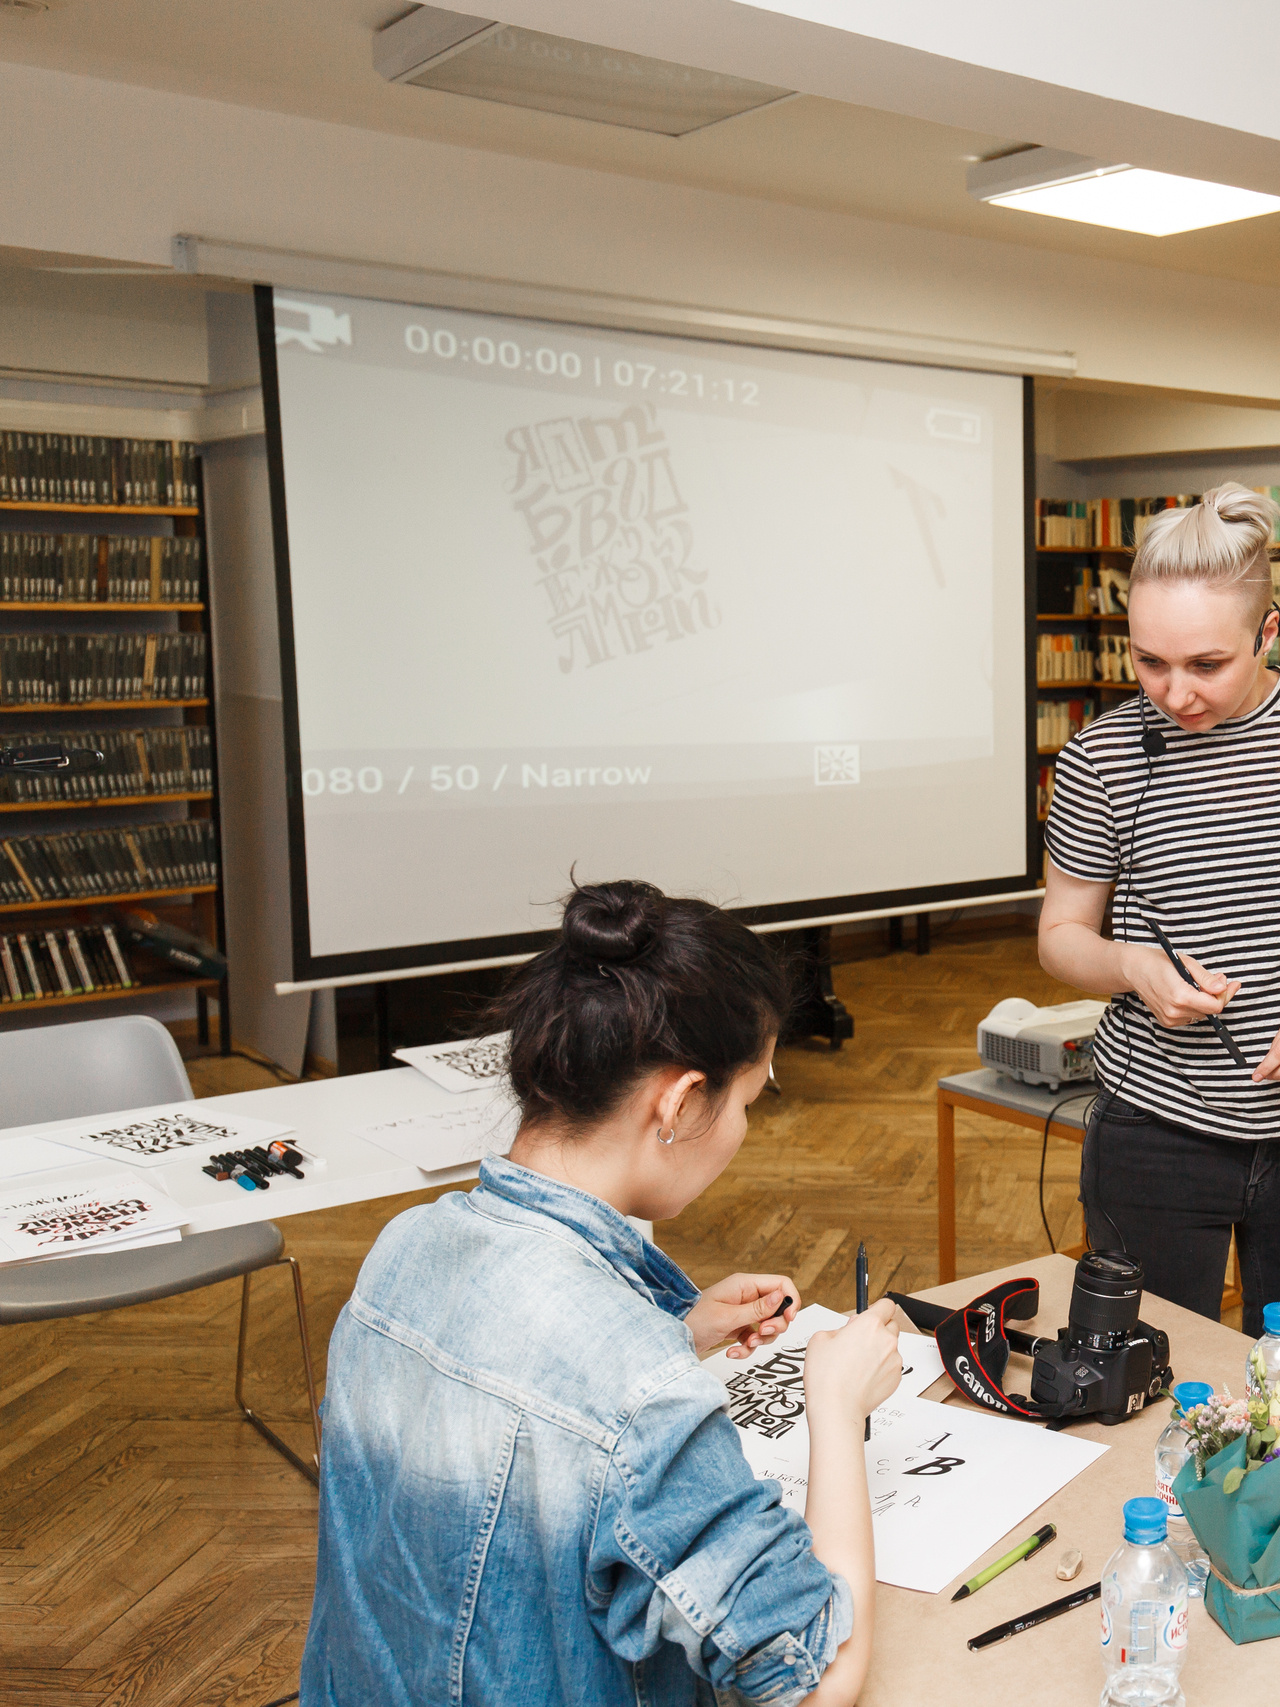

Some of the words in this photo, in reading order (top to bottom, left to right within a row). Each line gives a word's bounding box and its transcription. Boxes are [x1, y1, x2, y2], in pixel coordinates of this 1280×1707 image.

[404, 325, 583, 379] 00:00:00
[612, 360, 761, 406] 07:21:12
[429, 764, 480, 792] 50
[520, 763, 653, 789] Narrow
[985, 1311, 996, 1342] EOS
[955, 1355, 1008, 1412] Canon
